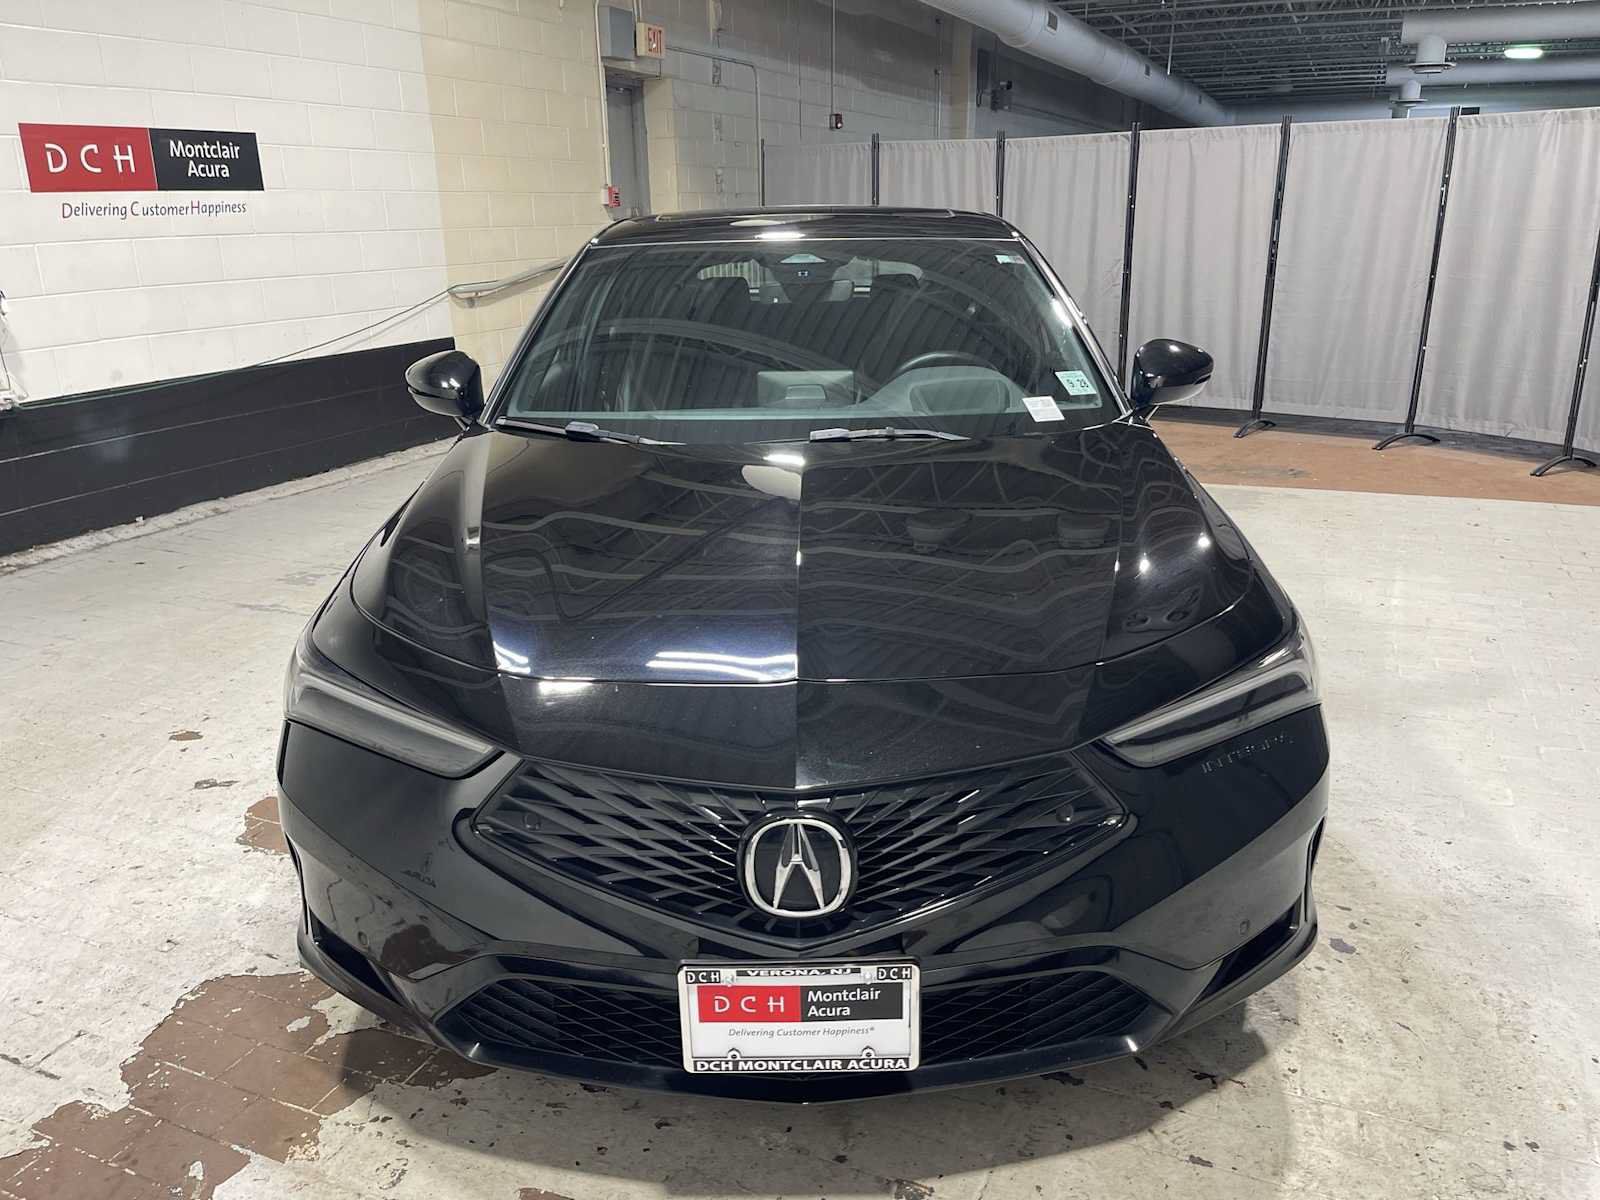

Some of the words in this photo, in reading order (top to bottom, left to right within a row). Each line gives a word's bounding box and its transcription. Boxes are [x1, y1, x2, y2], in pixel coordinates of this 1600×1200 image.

[44, 143, 136, 173] DCH
[169, 140, 240, 160] Montclair
[187, 160, 230, 178] Acura
[61, 202, 128, 220] Delivering
[130, 201, 190, 217] Customer
[190, 200, 247, 217] Happiness
[686, 971, 721, 984] DCH
[878, 967, 912, 980] DCH
[714, 996, 785, 1013] DCH
[807, 988, 881, 1002] Montclair
[807, 1005, 851, 1017] Acura
[728, 1028, 775, 1038] Delivering
[776, 1028, 821, 1037] Customer
[696, 1060, 734, 1072] DCH
[737, 1059, 843, 1071] MONTCLAIR
[847, 1058, 908, 1070] ACURA
